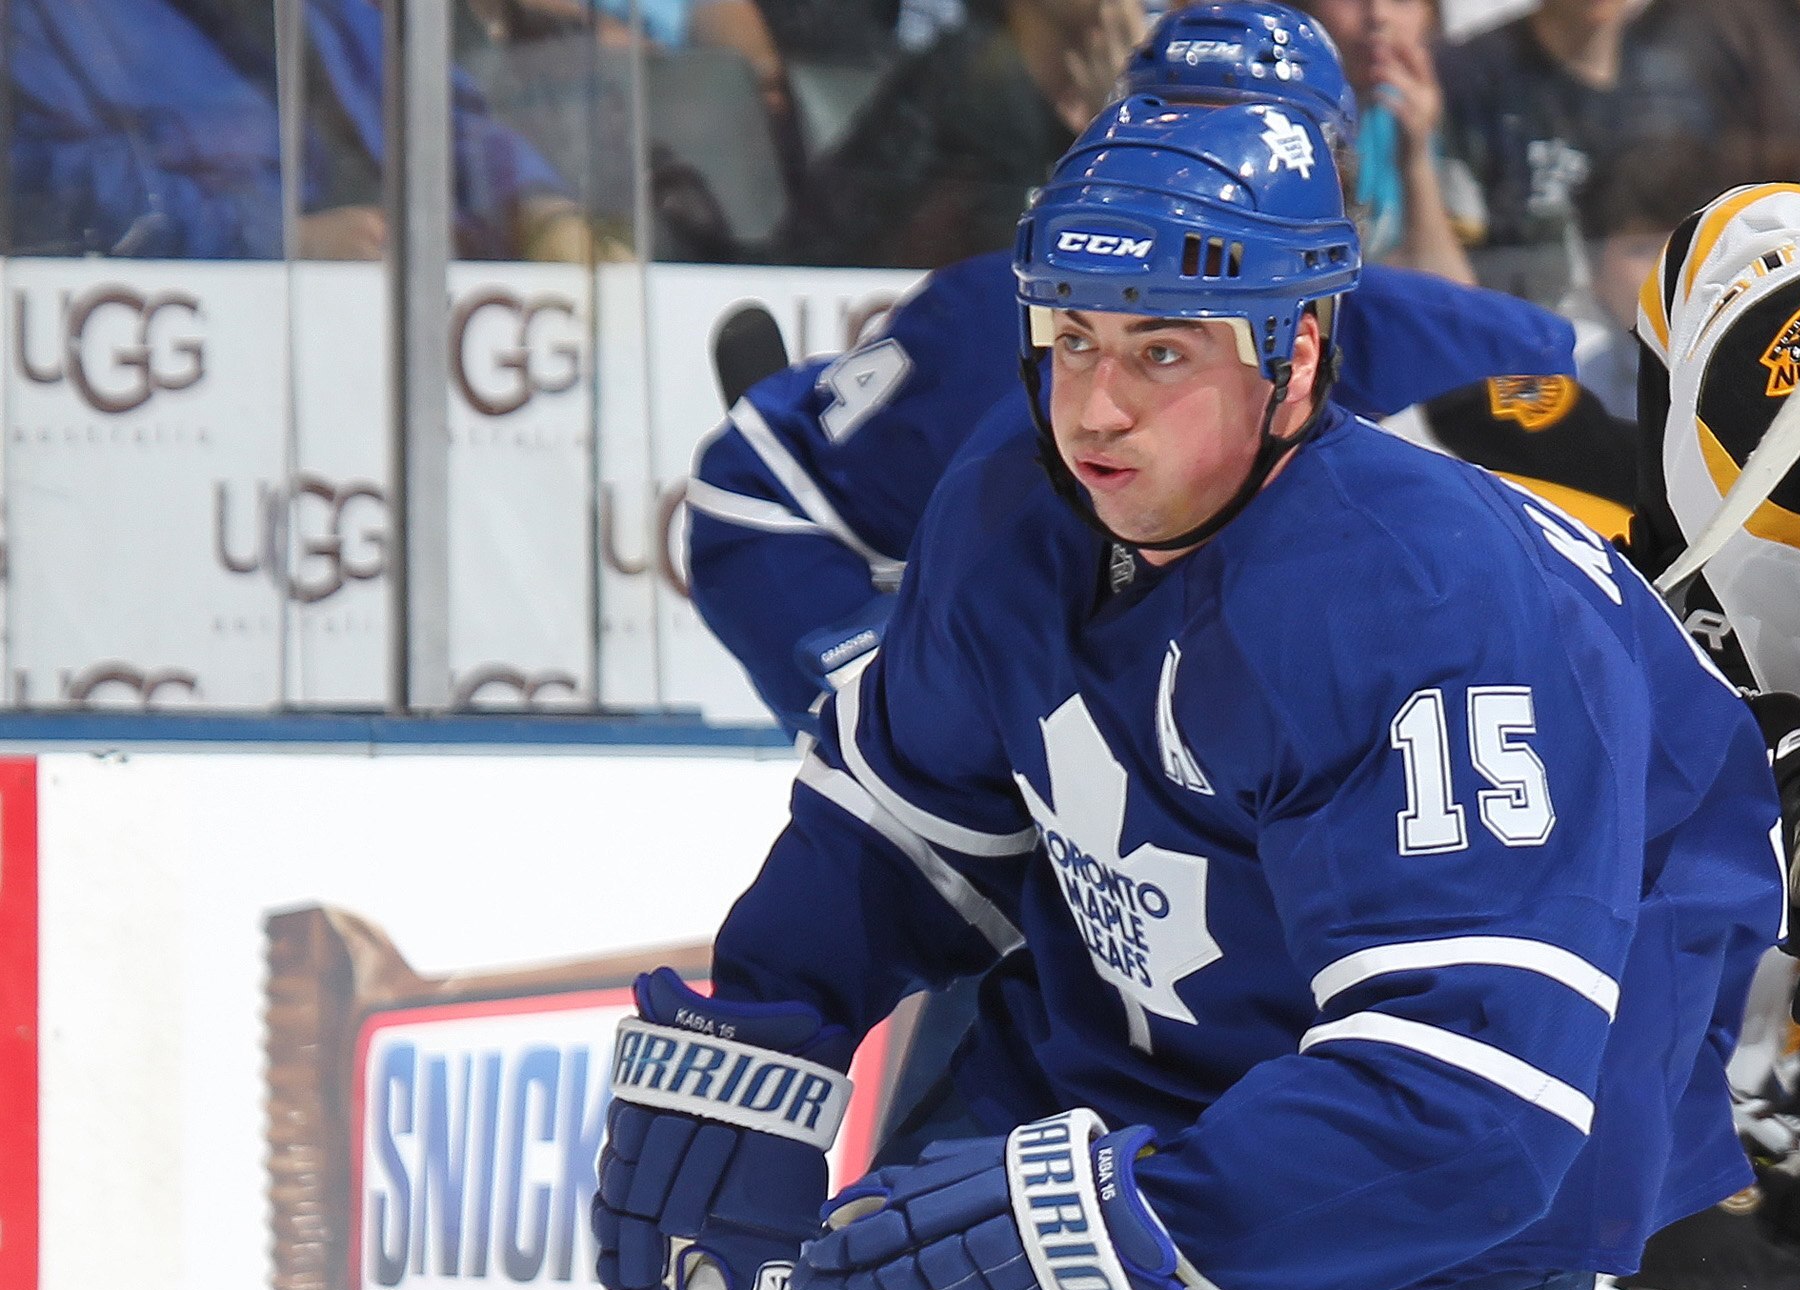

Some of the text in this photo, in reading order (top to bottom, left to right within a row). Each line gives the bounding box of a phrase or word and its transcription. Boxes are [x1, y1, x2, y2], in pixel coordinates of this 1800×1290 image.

[1166, 39, 1243, 64] CCM
[1056, 230, 1153, 259] CCM
[12, 281, 209, 414] UGG
[447, 281, 581, 416] GG
[213, 474, 389, 603] UGG
[1390, 685, 1557, 856] 15
[1063, 868, 1150, 954] MAPLE
[1077, 911, 1153, 989] LEAFS
